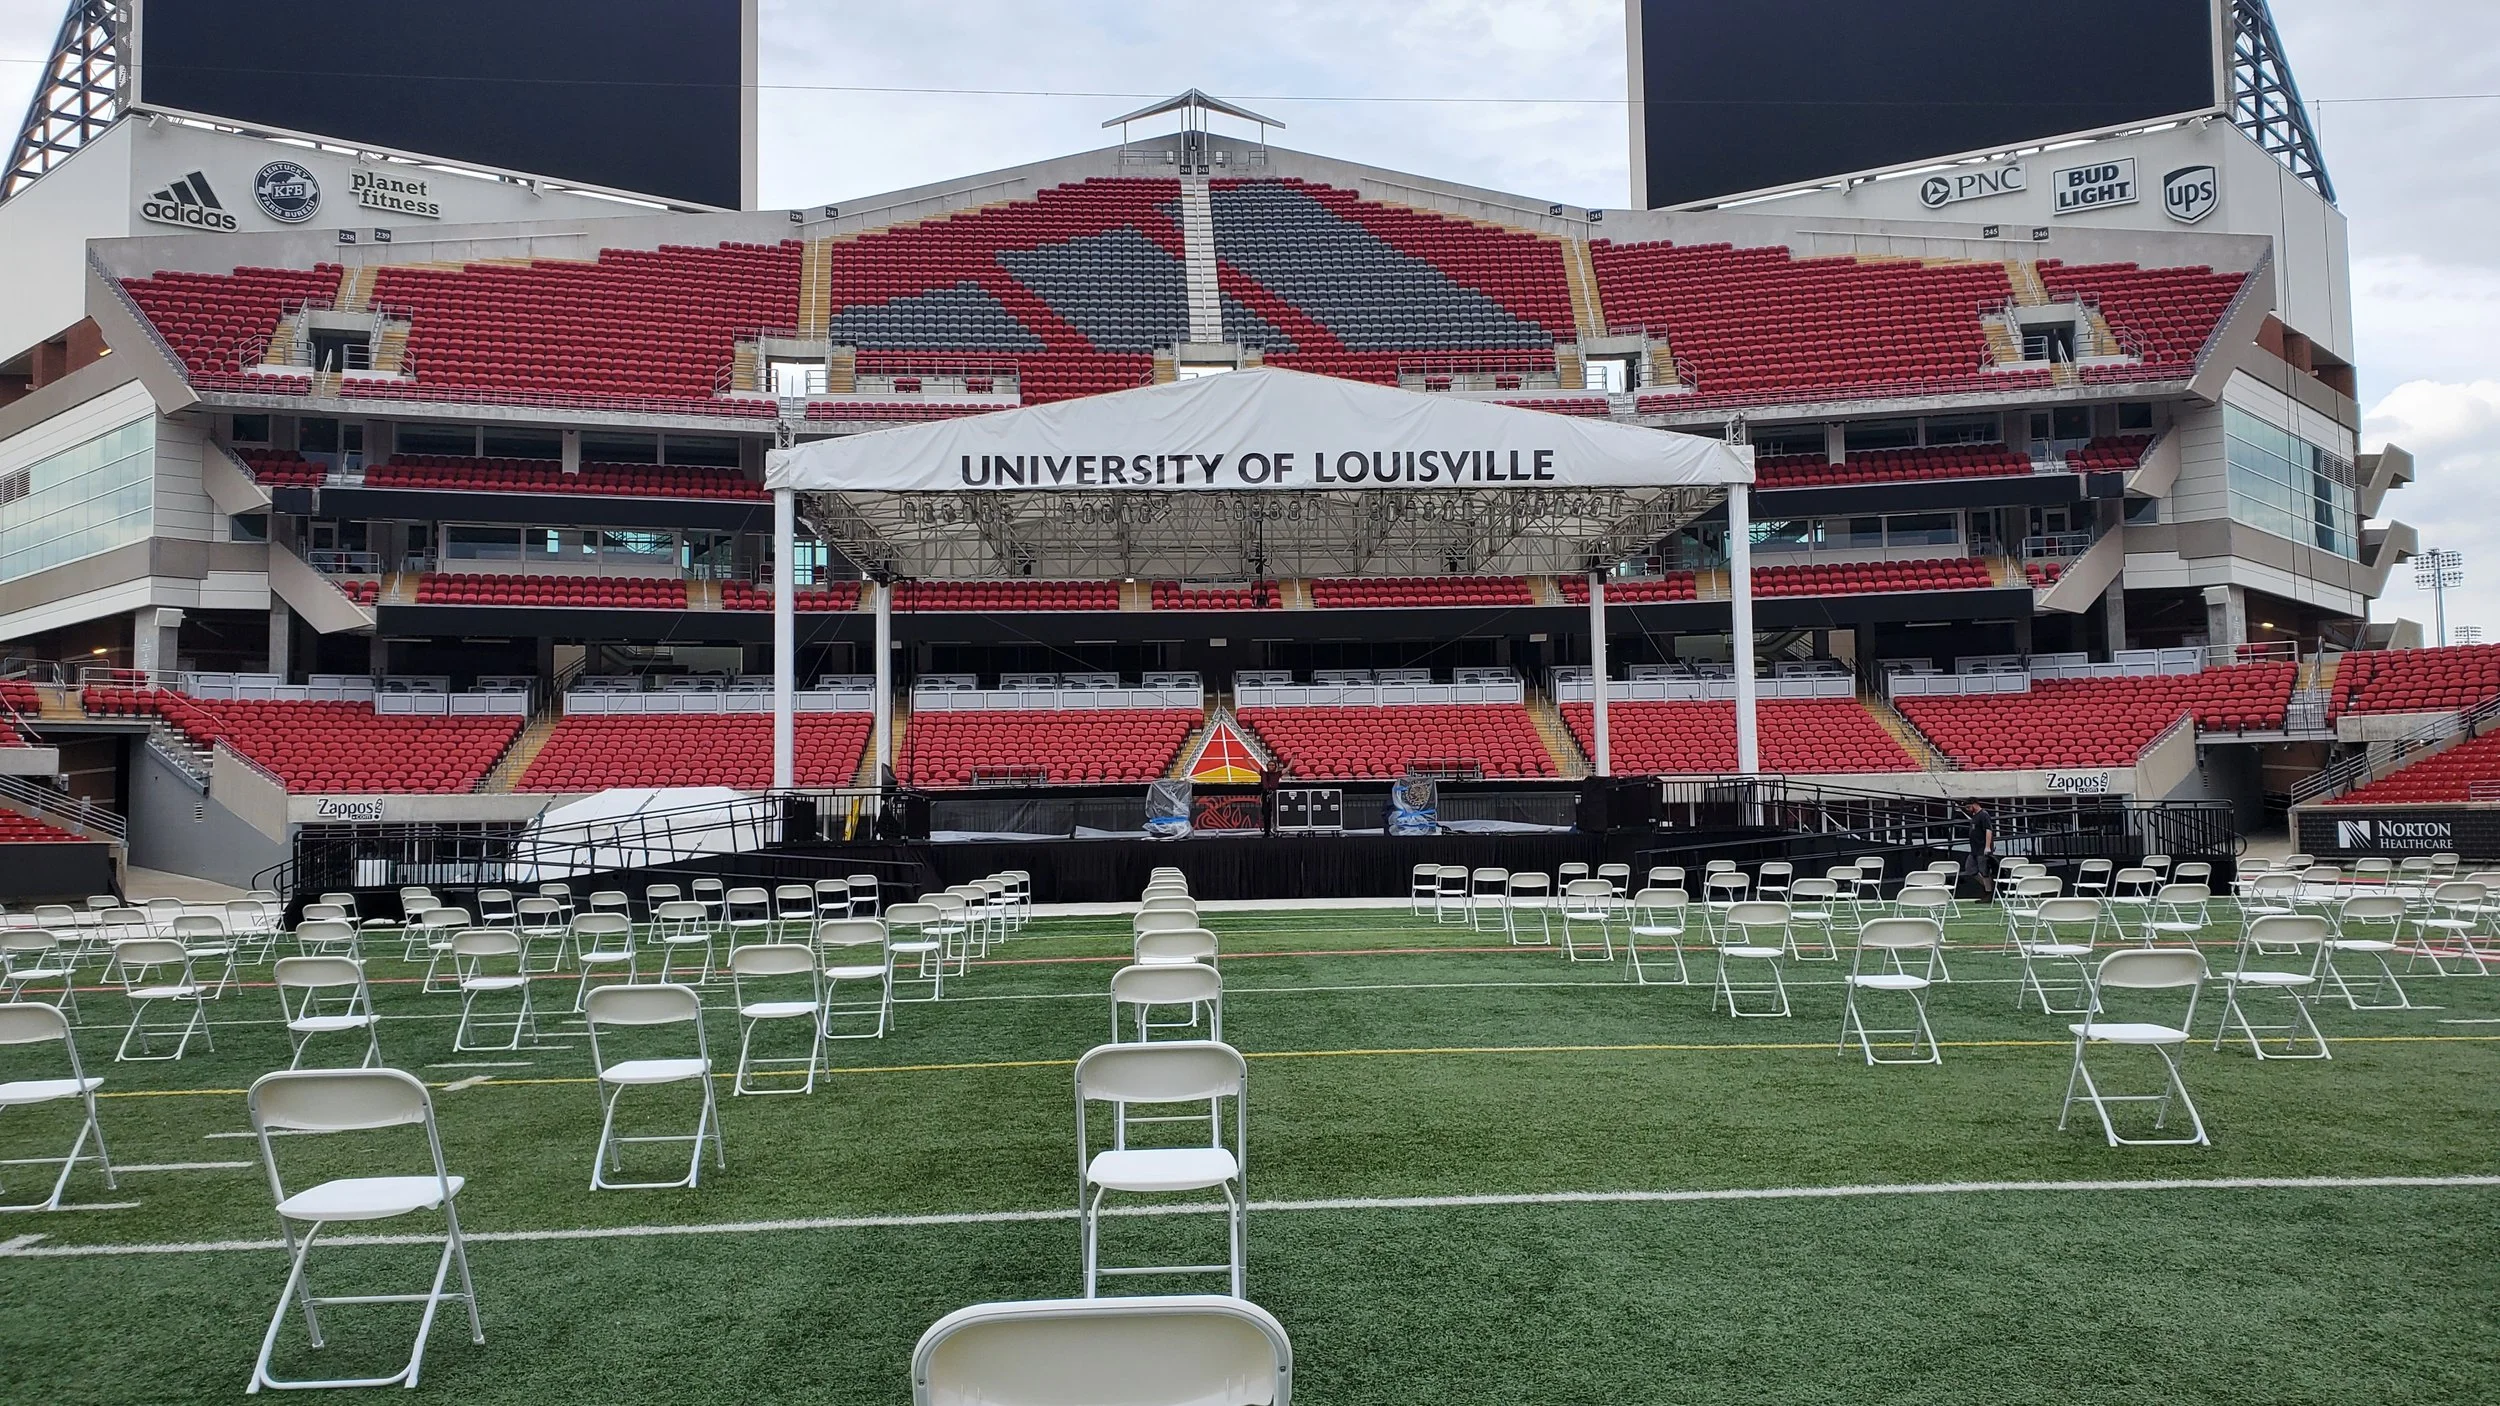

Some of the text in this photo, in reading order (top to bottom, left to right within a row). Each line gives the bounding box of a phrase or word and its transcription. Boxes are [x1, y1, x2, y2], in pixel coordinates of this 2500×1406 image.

[261, 164, 309, 178] KENTUCKY
[2068, 165, 2119, 188] BUD
[274, 184, 303, 197] KFB
[351, 172, 427, 196] planet
[1955, 167, 2022, 198] PNC
[361, 188, 439, 215] fitness
[2059, 181, 2131, 208] LIGHT
[2169, 181, 2213, 212] ups
[143, 202, 237, 230] adidas
[261, 196, 315, 218] FARM BUREAU
[340, 232, 355, 241] 238
[375, 231, 390, 240] 239
[1984, 227, 1998, 236] 245
[2034, 230, 2048, 239] 246
[961, 450, 1556, 486] UNIVERSITY OF LOUISVILLE
[2046, 773, 2099, 791] Zappos
[318, 798, 373, 818] Zappos
[2378, 820, 2451, 837] NORTON
[2380, 839, 2453, 849] HEALTHCARE
